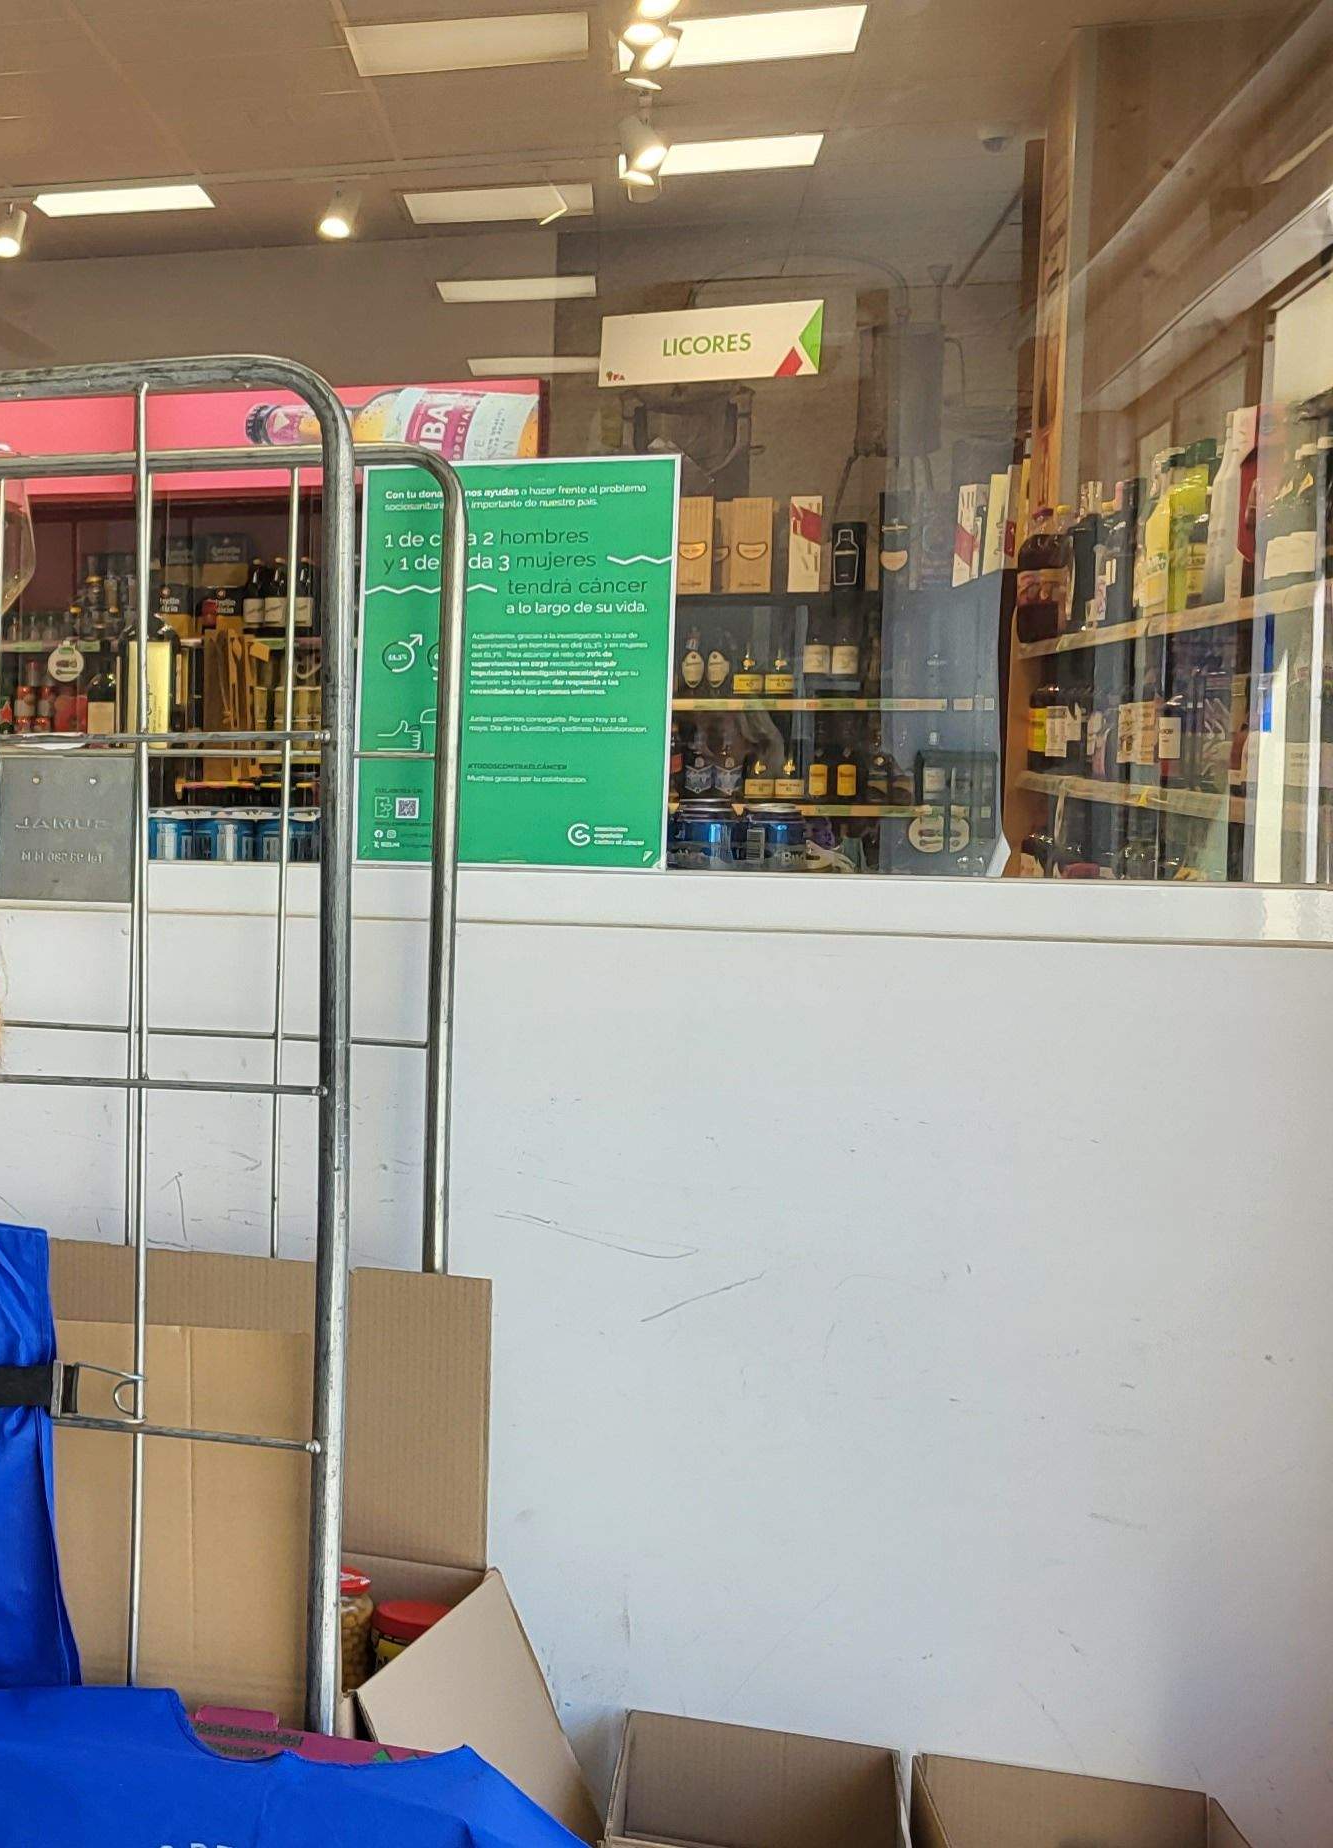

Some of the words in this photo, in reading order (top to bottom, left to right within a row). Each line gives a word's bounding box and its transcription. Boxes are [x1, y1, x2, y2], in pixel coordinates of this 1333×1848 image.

[663, 333, 751, 357] LICORES
[385, 491, 405, 500] Con
[407, 490, 417, 498] tu
[419, 490, 442, 498] dona
[484, 487, 519, 498] ayudas
[530, 486, 556, 494] hacer
[558, 485, 588, 494] frente
[599, 484, 646, 495] problema
[471, 499, 522, 510] importante
[539, 499, 576, 507] nuestro
[385, 534, 394, 548] 1
[399, 530, 424, 547] de
[483, 532, 494, 546] 2
[500, 529, 589, 545] hombres
[383, 559, 395, 575] y
[399, 558, 409, 571] 1
[414, 554, 439, 571] de
[498, 555, 510, 572] 3
[516, 551, 596, 571] mujeres
[508, 577, 572, 595] tendrá
[579, 577, 648, 594] cáncer
[506, 604, 515, 613] a
[519, 602, 531, 613] lo
[535, 602, 571, 616] largo
[574, 601, 592, 613] de
[595, 603, 613, 613] su
[615, 600, 648, 613] vida.
